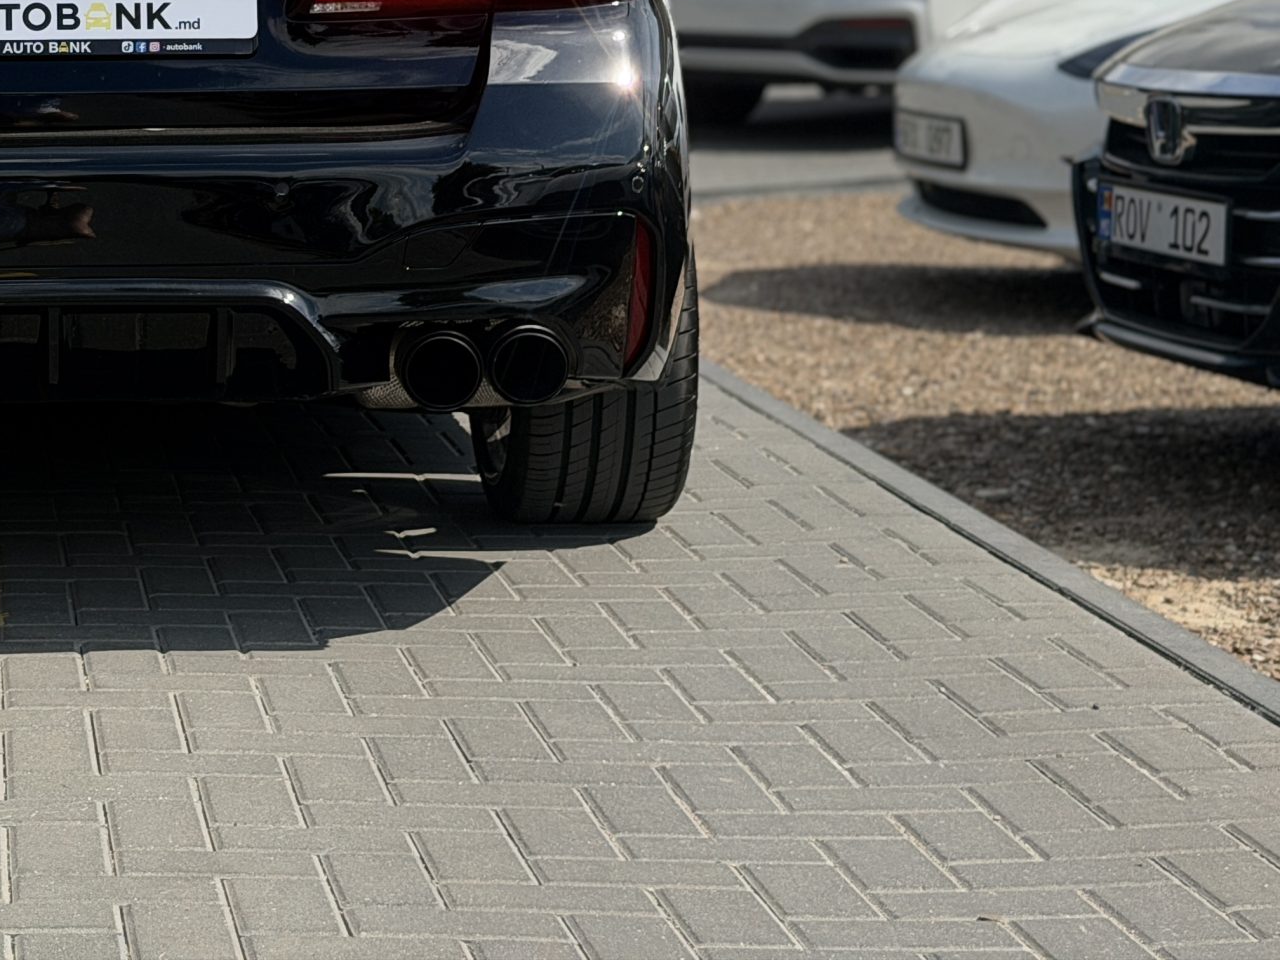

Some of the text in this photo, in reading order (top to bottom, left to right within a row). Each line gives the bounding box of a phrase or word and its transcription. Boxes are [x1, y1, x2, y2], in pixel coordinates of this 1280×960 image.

[2, 42, 44, 54] AUTO
[1113, 194, 1151, 243] ROV
[1168, 205, 1211, 257] 102
